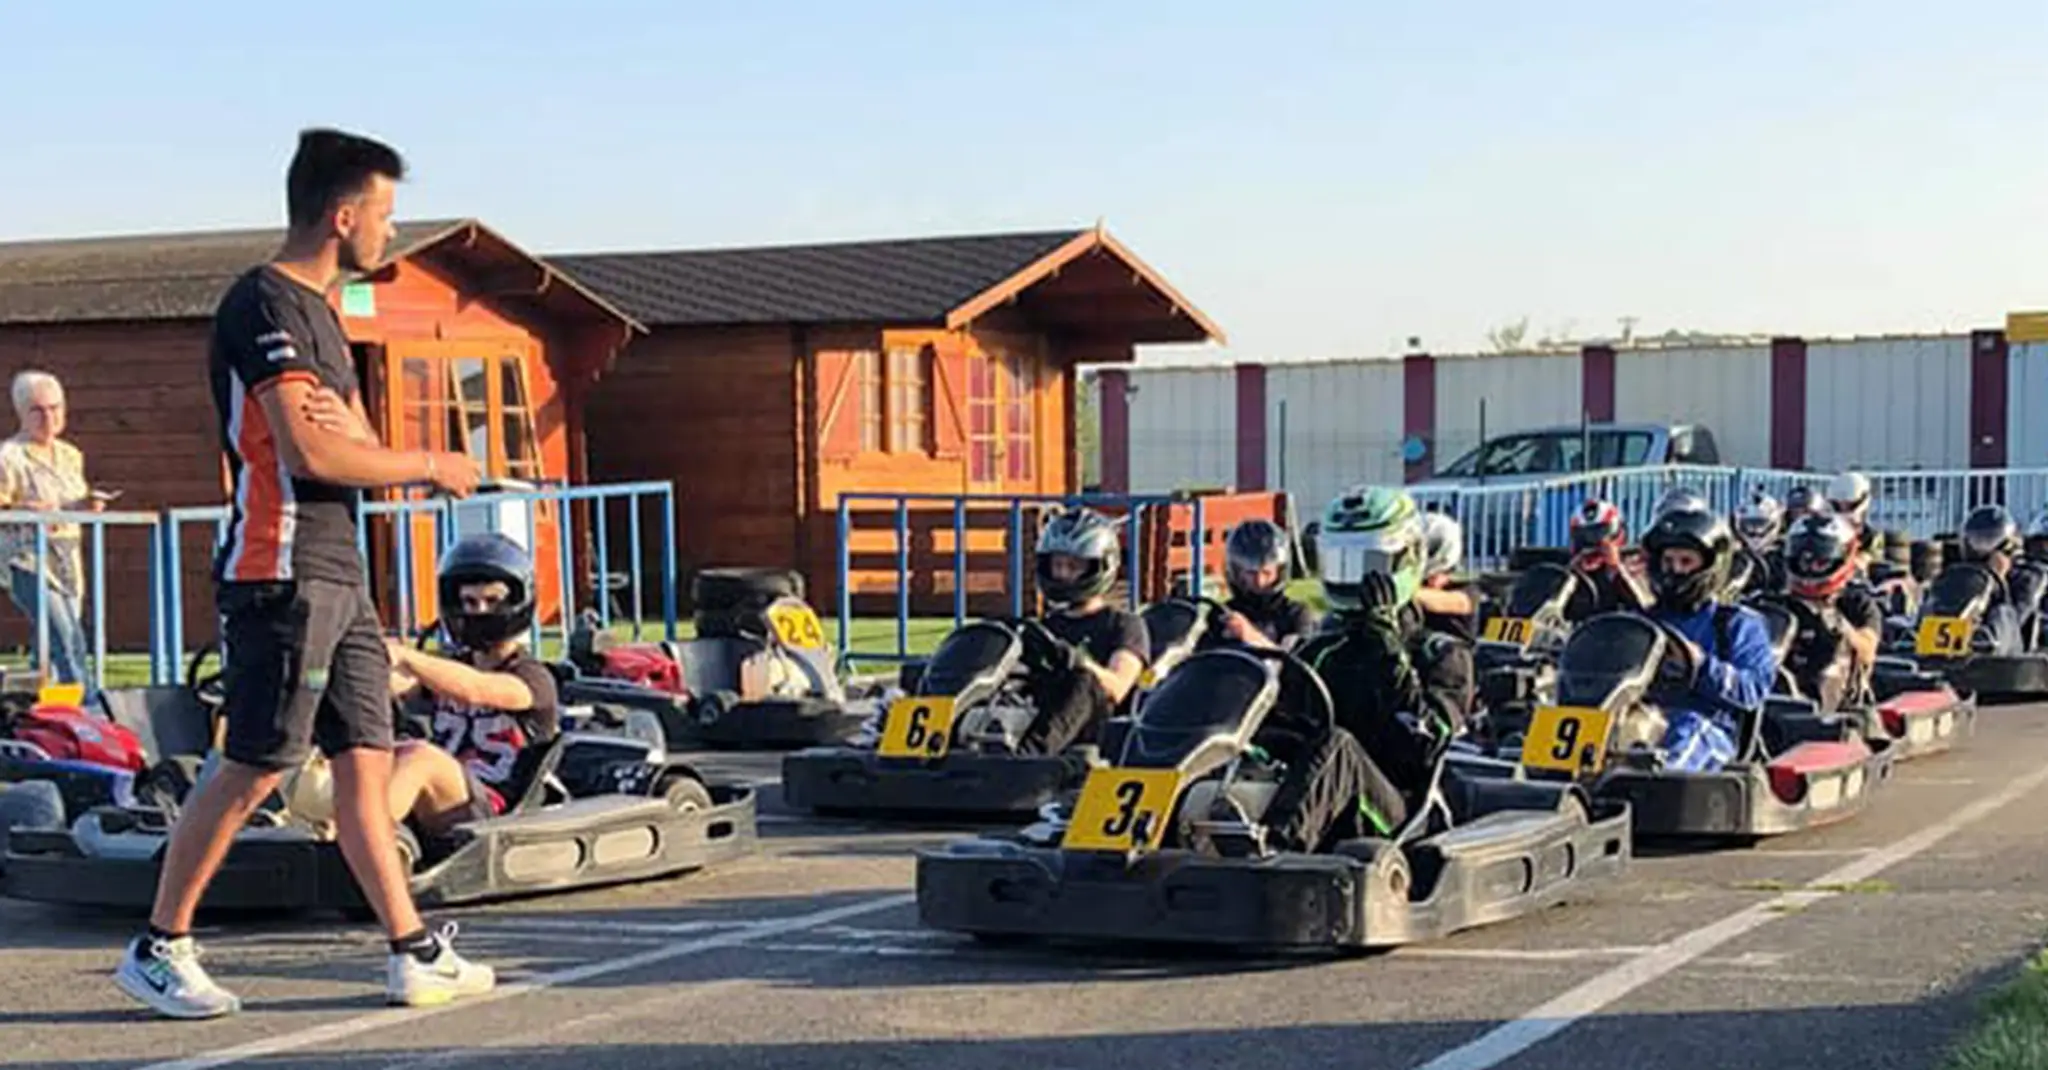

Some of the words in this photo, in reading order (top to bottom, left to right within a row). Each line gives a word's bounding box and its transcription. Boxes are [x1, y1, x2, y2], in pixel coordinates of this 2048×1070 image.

[777, 615, 821, 644] 24
[1934, 622, 1951, 649] 5
[433, 711, 517, 784] 75
[906, 705, 931, 750] 6
[1552, 716, 1581, 761] 9
[1102, 780, 1146, 837] 3
